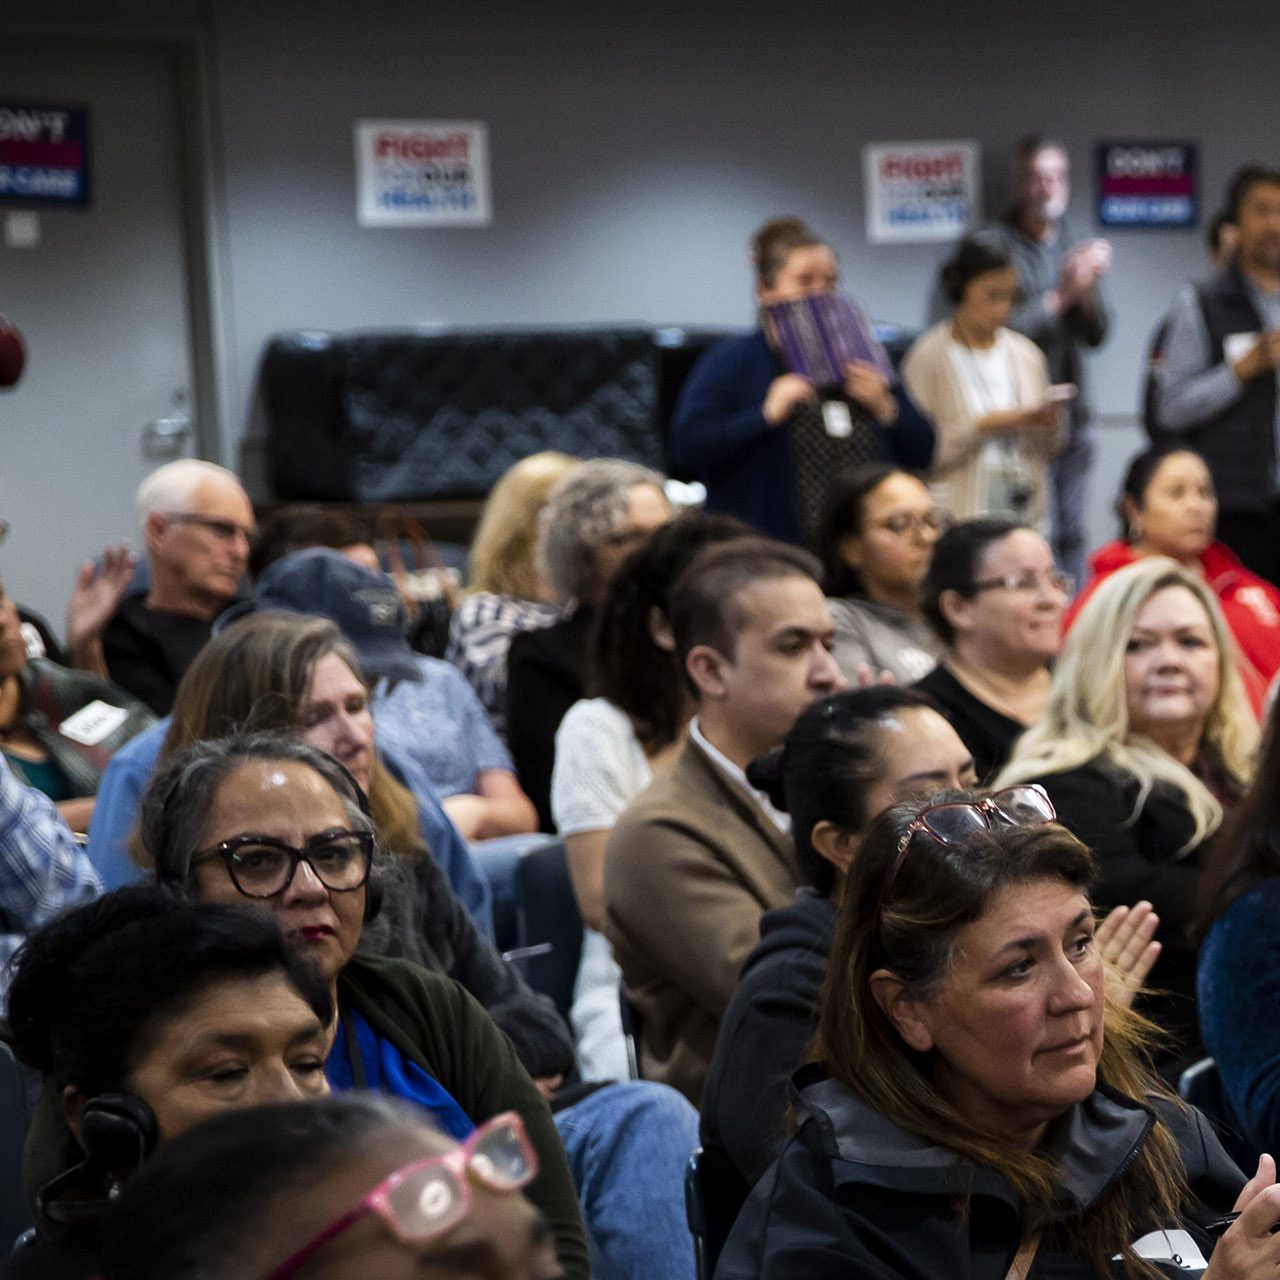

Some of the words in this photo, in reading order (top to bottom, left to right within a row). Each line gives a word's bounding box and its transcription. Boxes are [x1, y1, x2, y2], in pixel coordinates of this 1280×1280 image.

[0, 109, 68, 143] ON'T
[372, 131, 469, 165] FIGHT
[1106, 147, 1183, 177] DON'T
